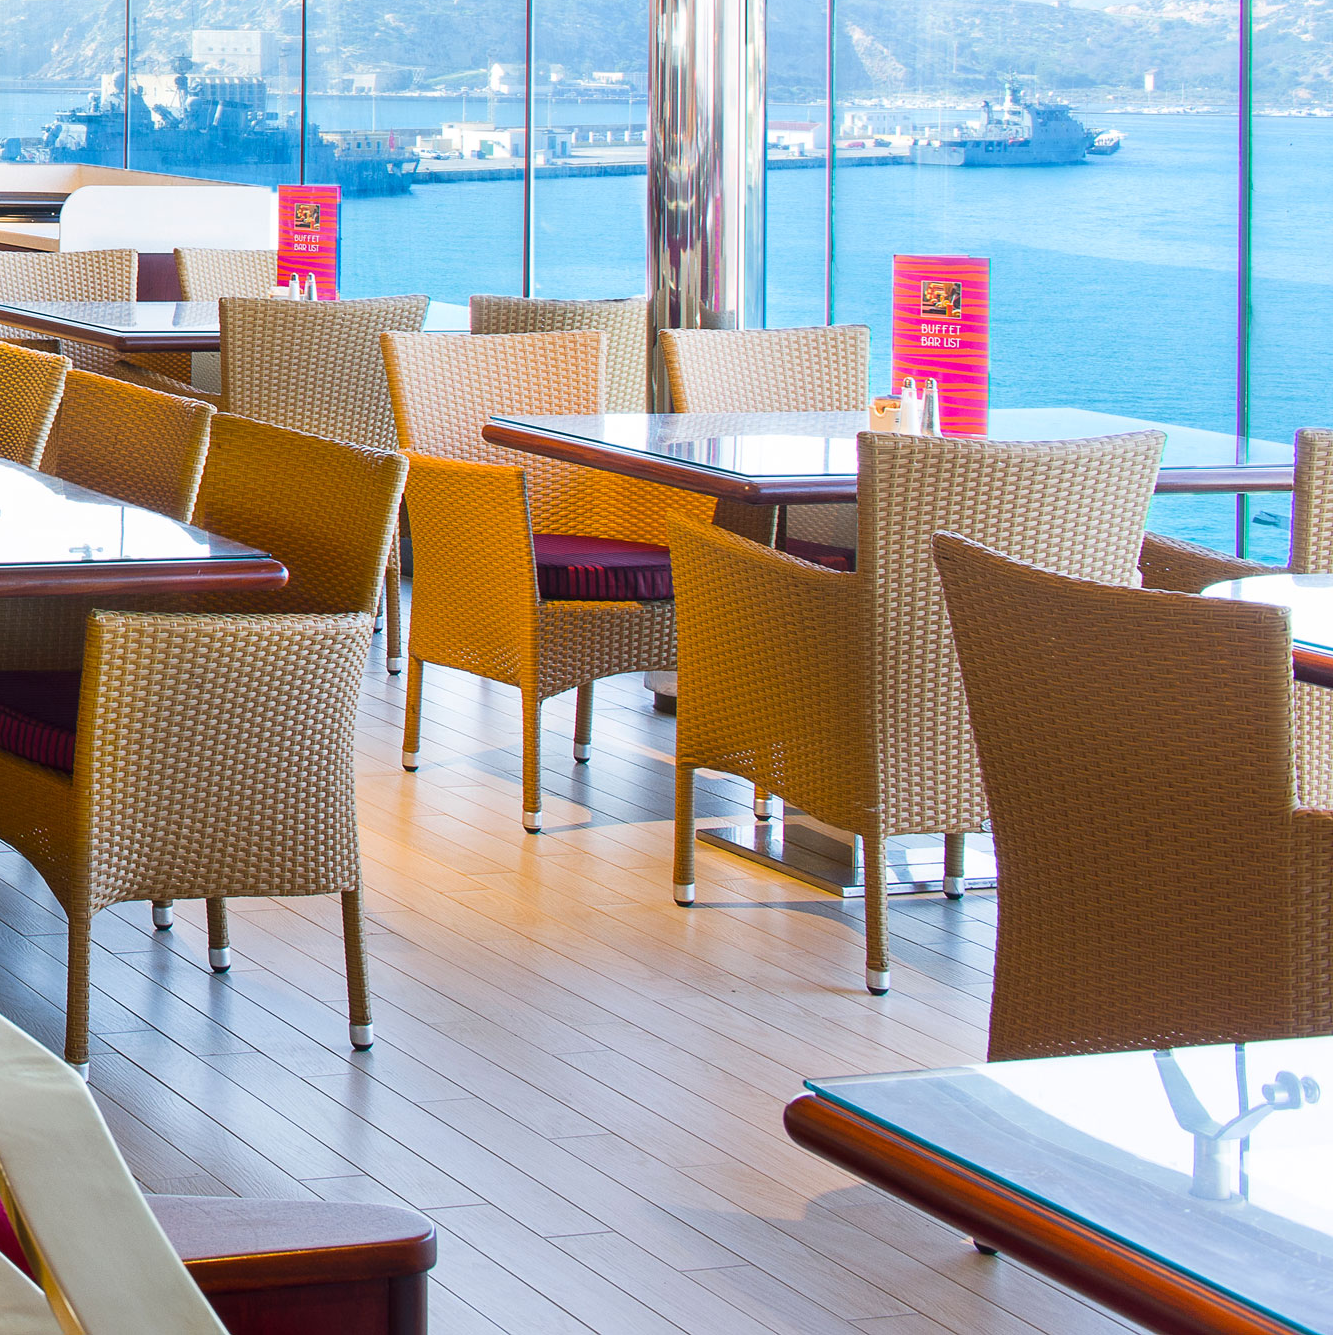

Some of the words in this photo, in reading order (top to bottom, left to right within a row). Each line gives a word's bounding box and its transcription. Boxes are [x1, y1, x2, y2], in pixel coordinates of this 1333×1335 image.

[294, 234, 320, 243] BUFFET
[294, 243, 307, 251] BAR
[308, 244, 320, 252] LIST
[921, 323, 962, 336] BUFFET
[921, 336, 941, 347] BAR
[943, 337, 961, 349] LIST
